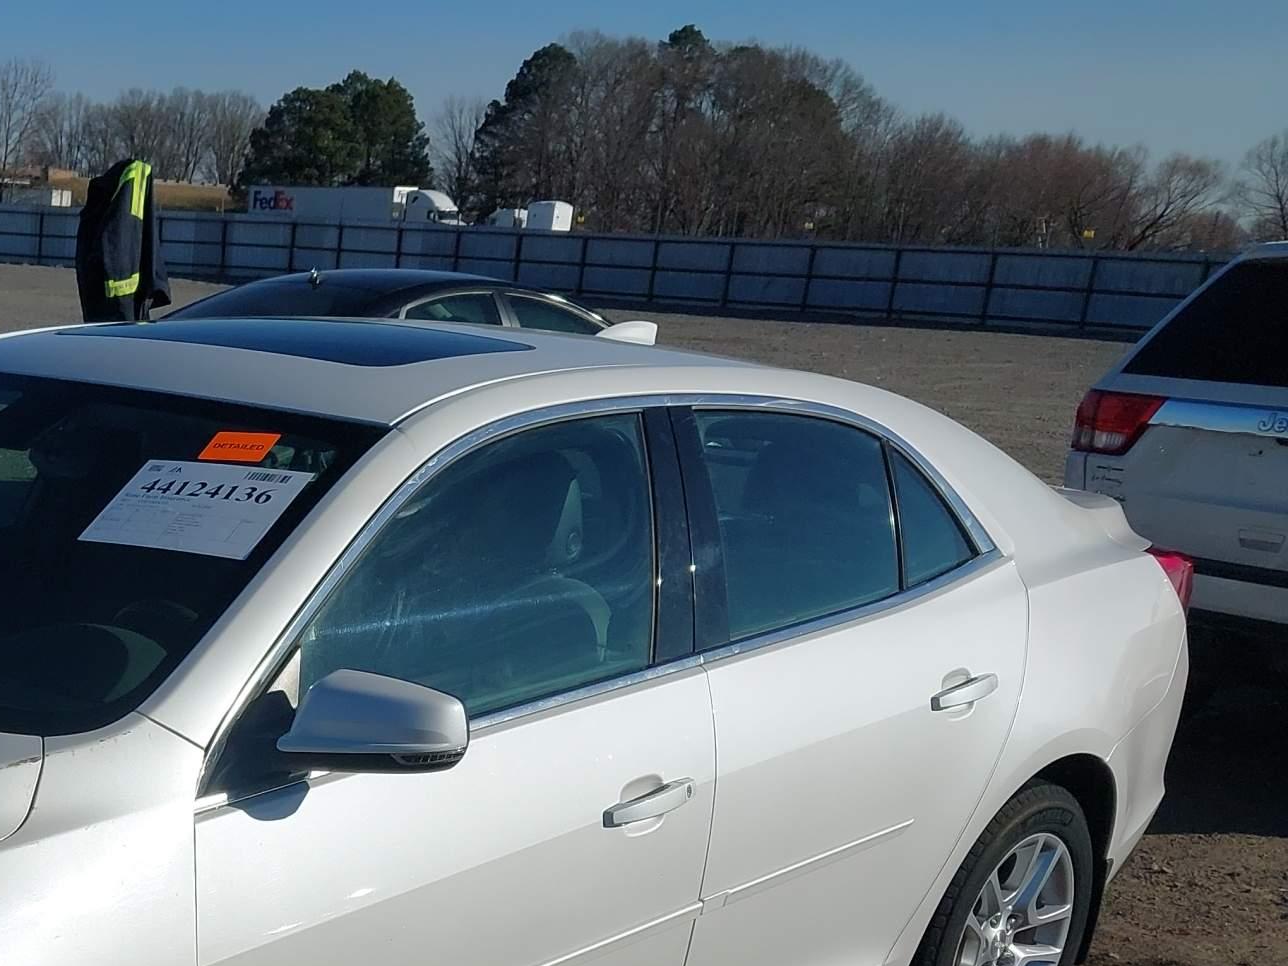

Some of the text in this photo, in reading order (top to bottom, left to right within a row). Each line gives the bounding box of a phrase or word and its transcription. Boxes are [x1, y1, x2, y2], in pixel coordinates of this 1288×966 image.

[253, 190, 294, 209] FedEx
[212, 442, 265, 450] DETAILED
[140, 478, 273, 505] 44124136
